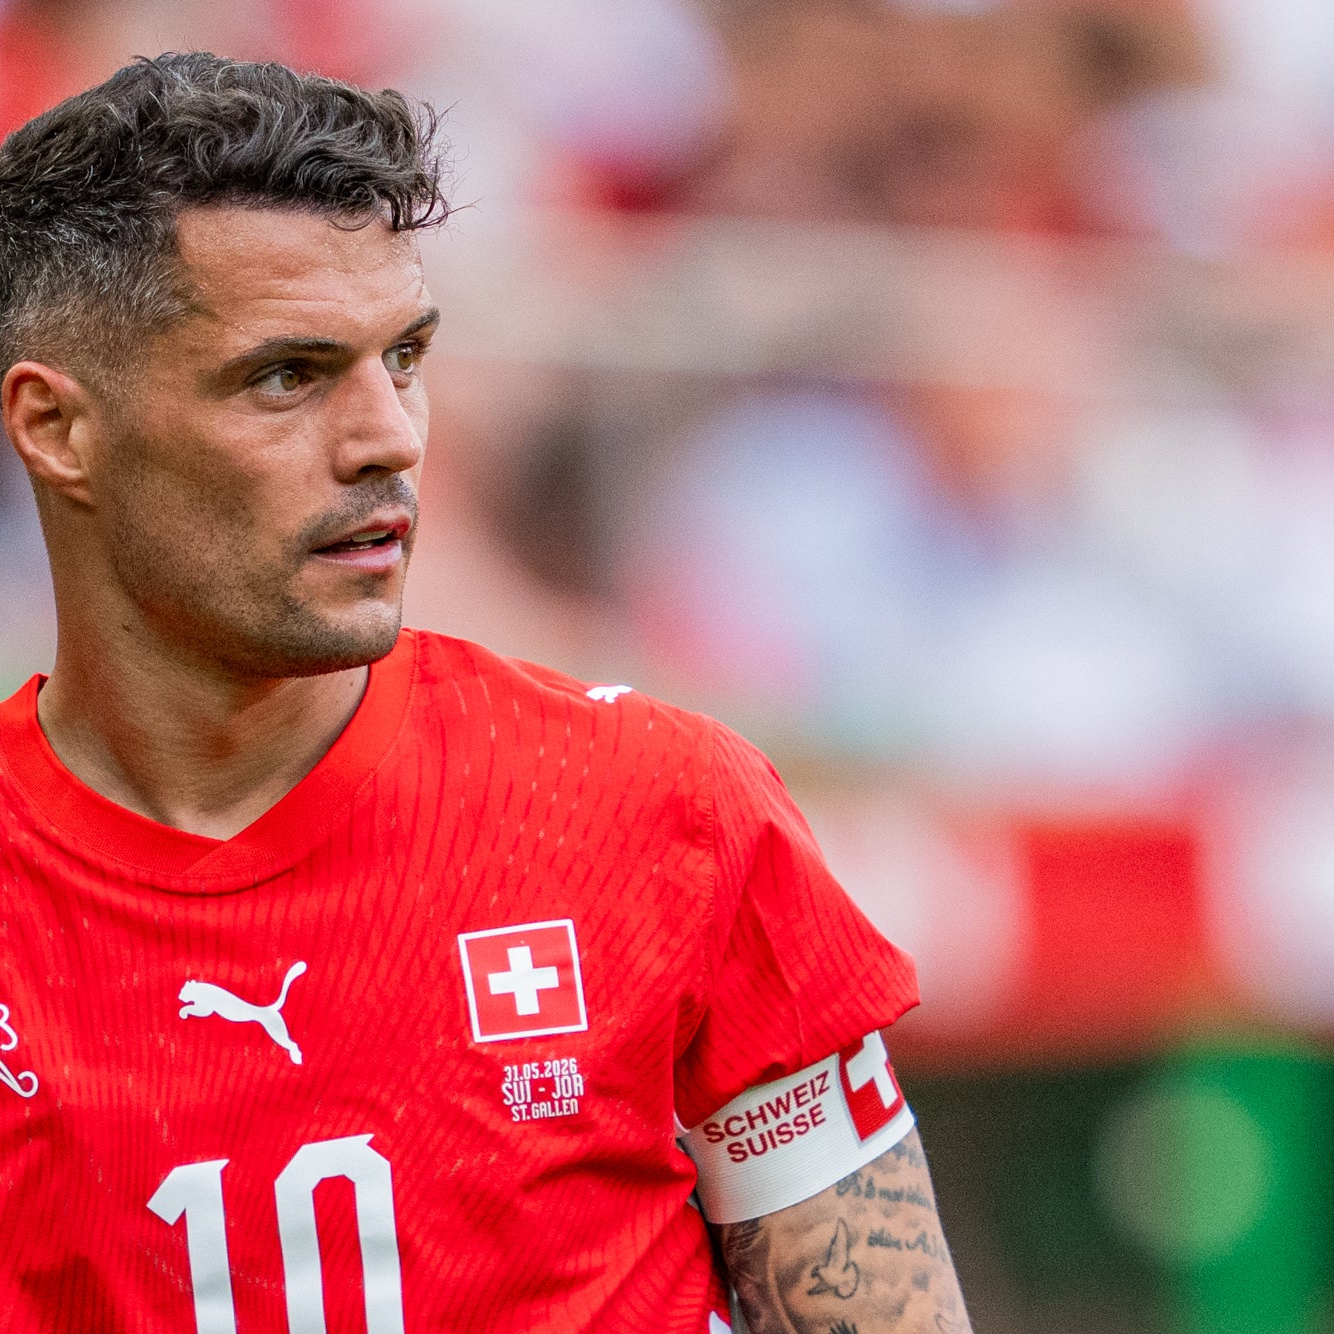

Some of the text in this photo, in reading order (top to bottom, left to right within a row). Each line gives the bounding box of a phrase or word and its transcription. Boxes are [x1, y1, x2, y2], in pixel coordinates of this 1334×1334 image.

[501, 1080, 532, 1106] SUI
[551, 1074, 584, 1100] JOR
[504, 1058, 578, 1082] 31.05.2026
[703, 1070, 831, 1144] SCHWEIZ
[727, 1102, 827, 1163] SUISSE
